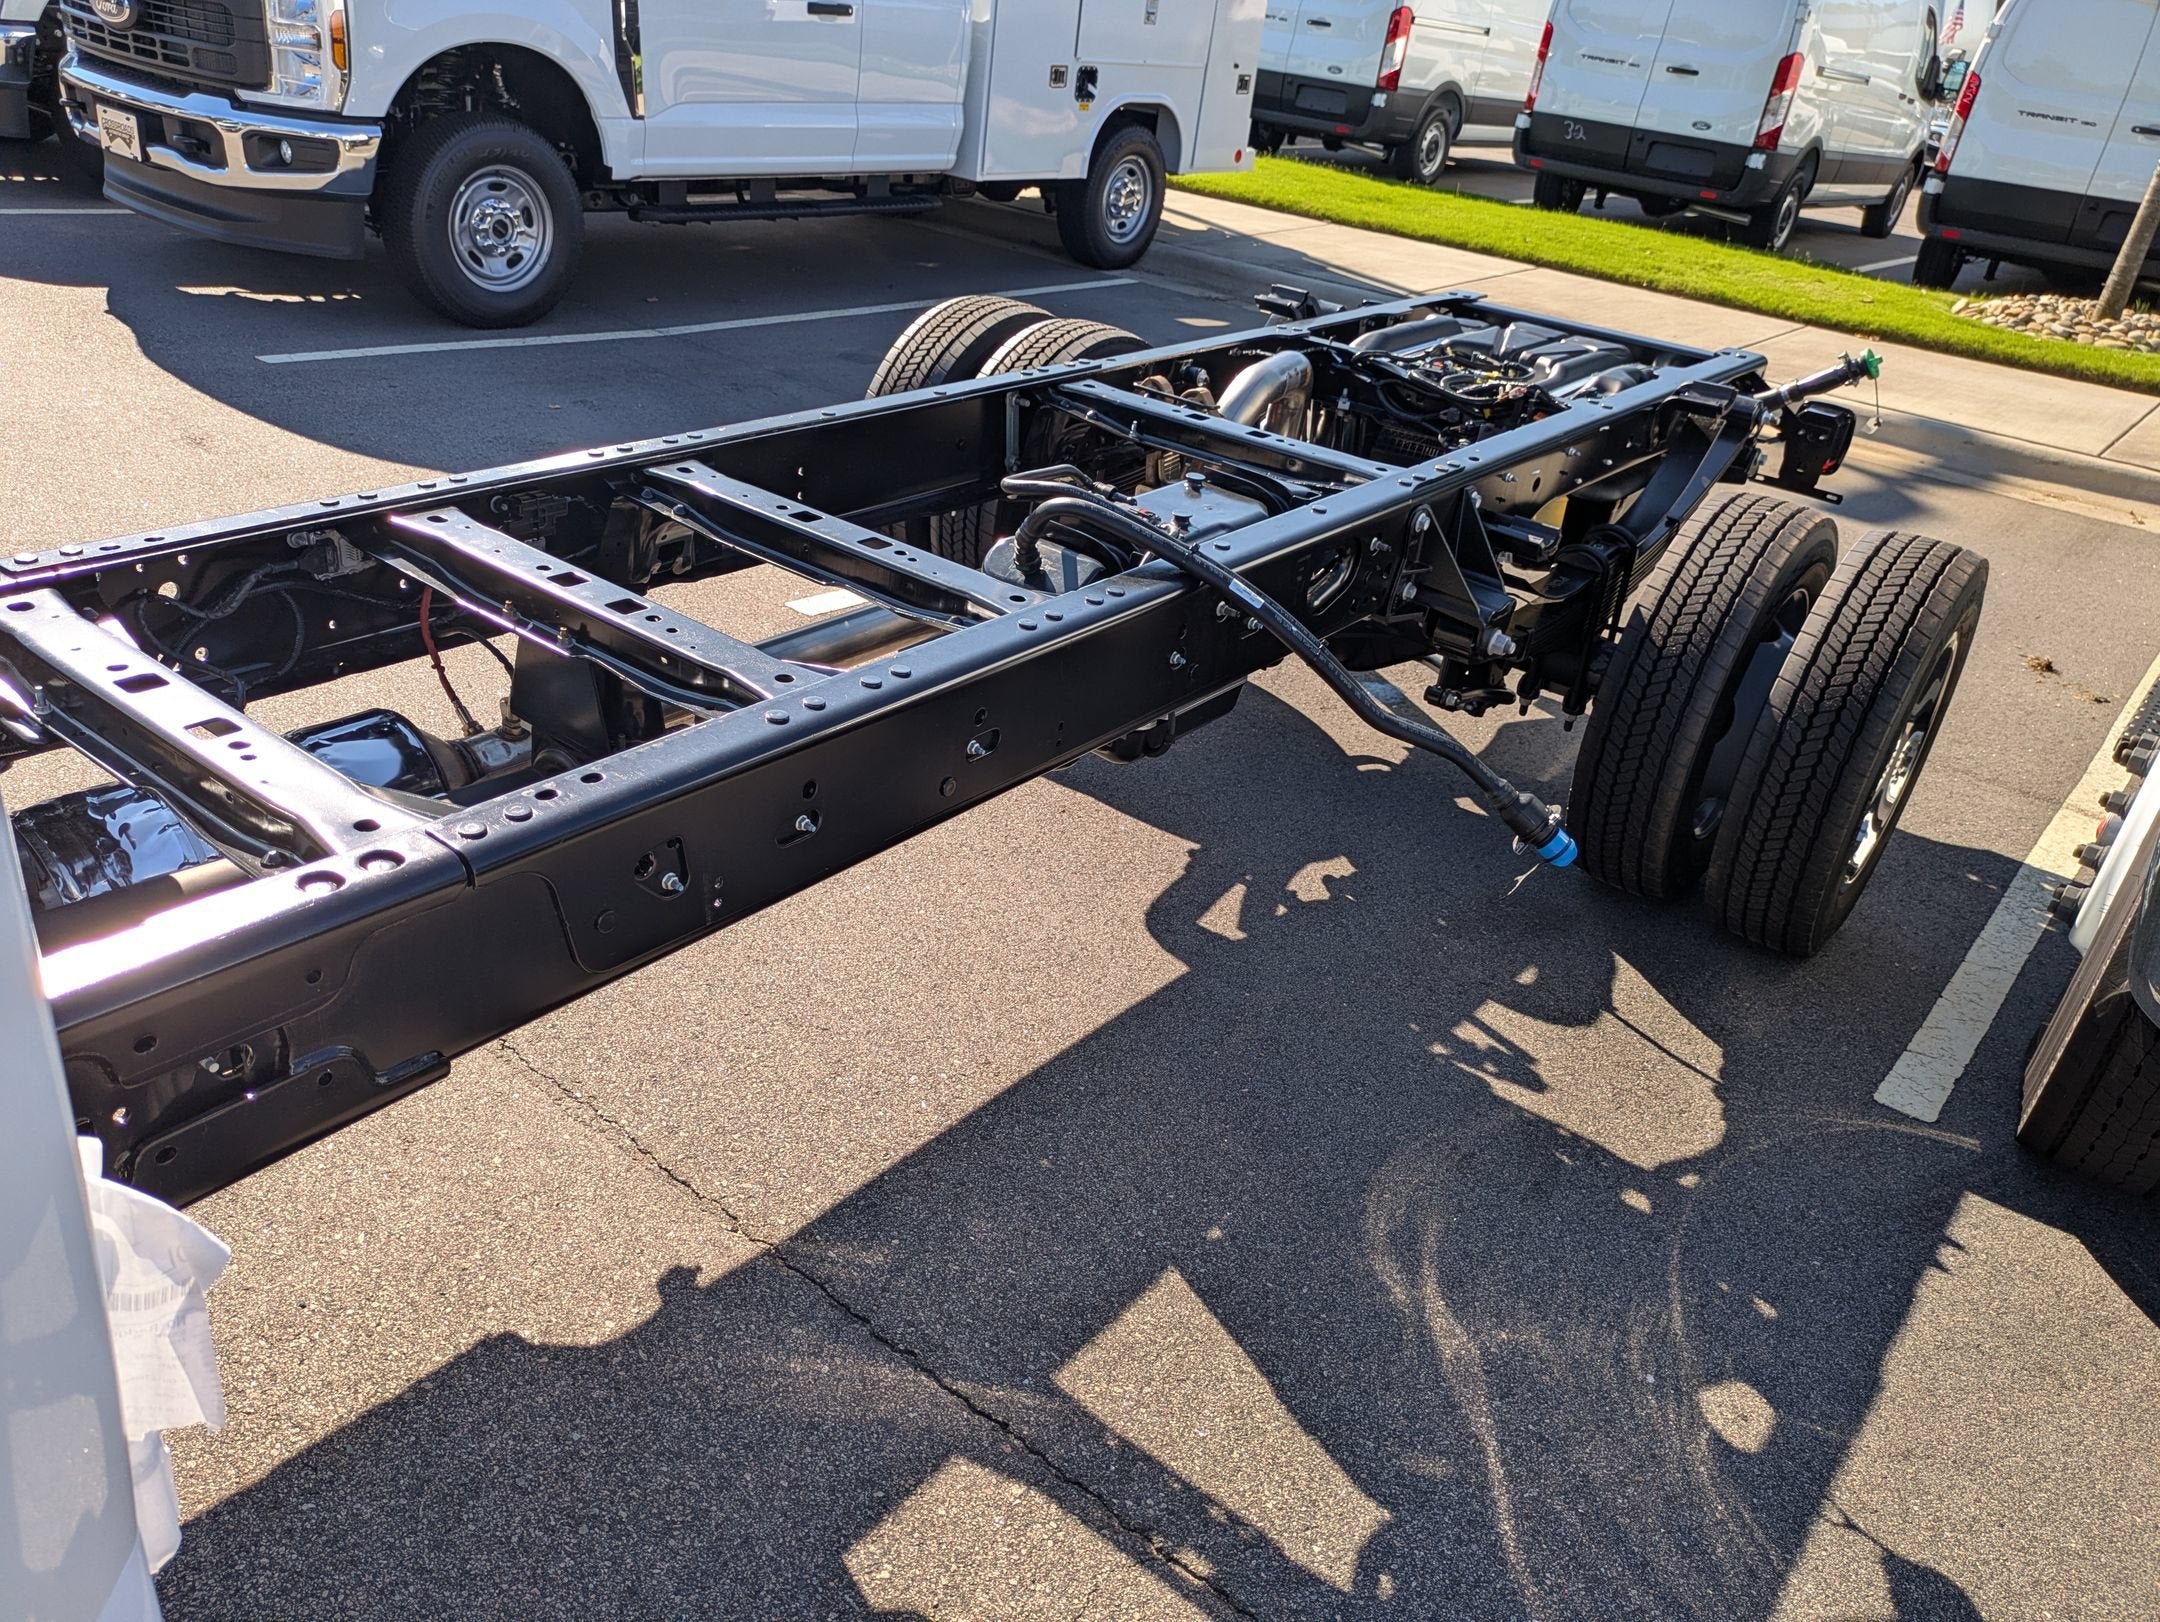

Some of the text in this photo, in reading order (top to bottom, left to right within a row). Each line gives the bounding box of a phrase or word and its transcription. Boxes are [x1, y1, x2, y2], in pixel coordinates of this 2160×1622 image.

[1581, 54, 1626, 65] TRANSIT
[2018, 110, 2079, 123] TRANSIT
[101, 117, 135, 140] CROSSROADS
